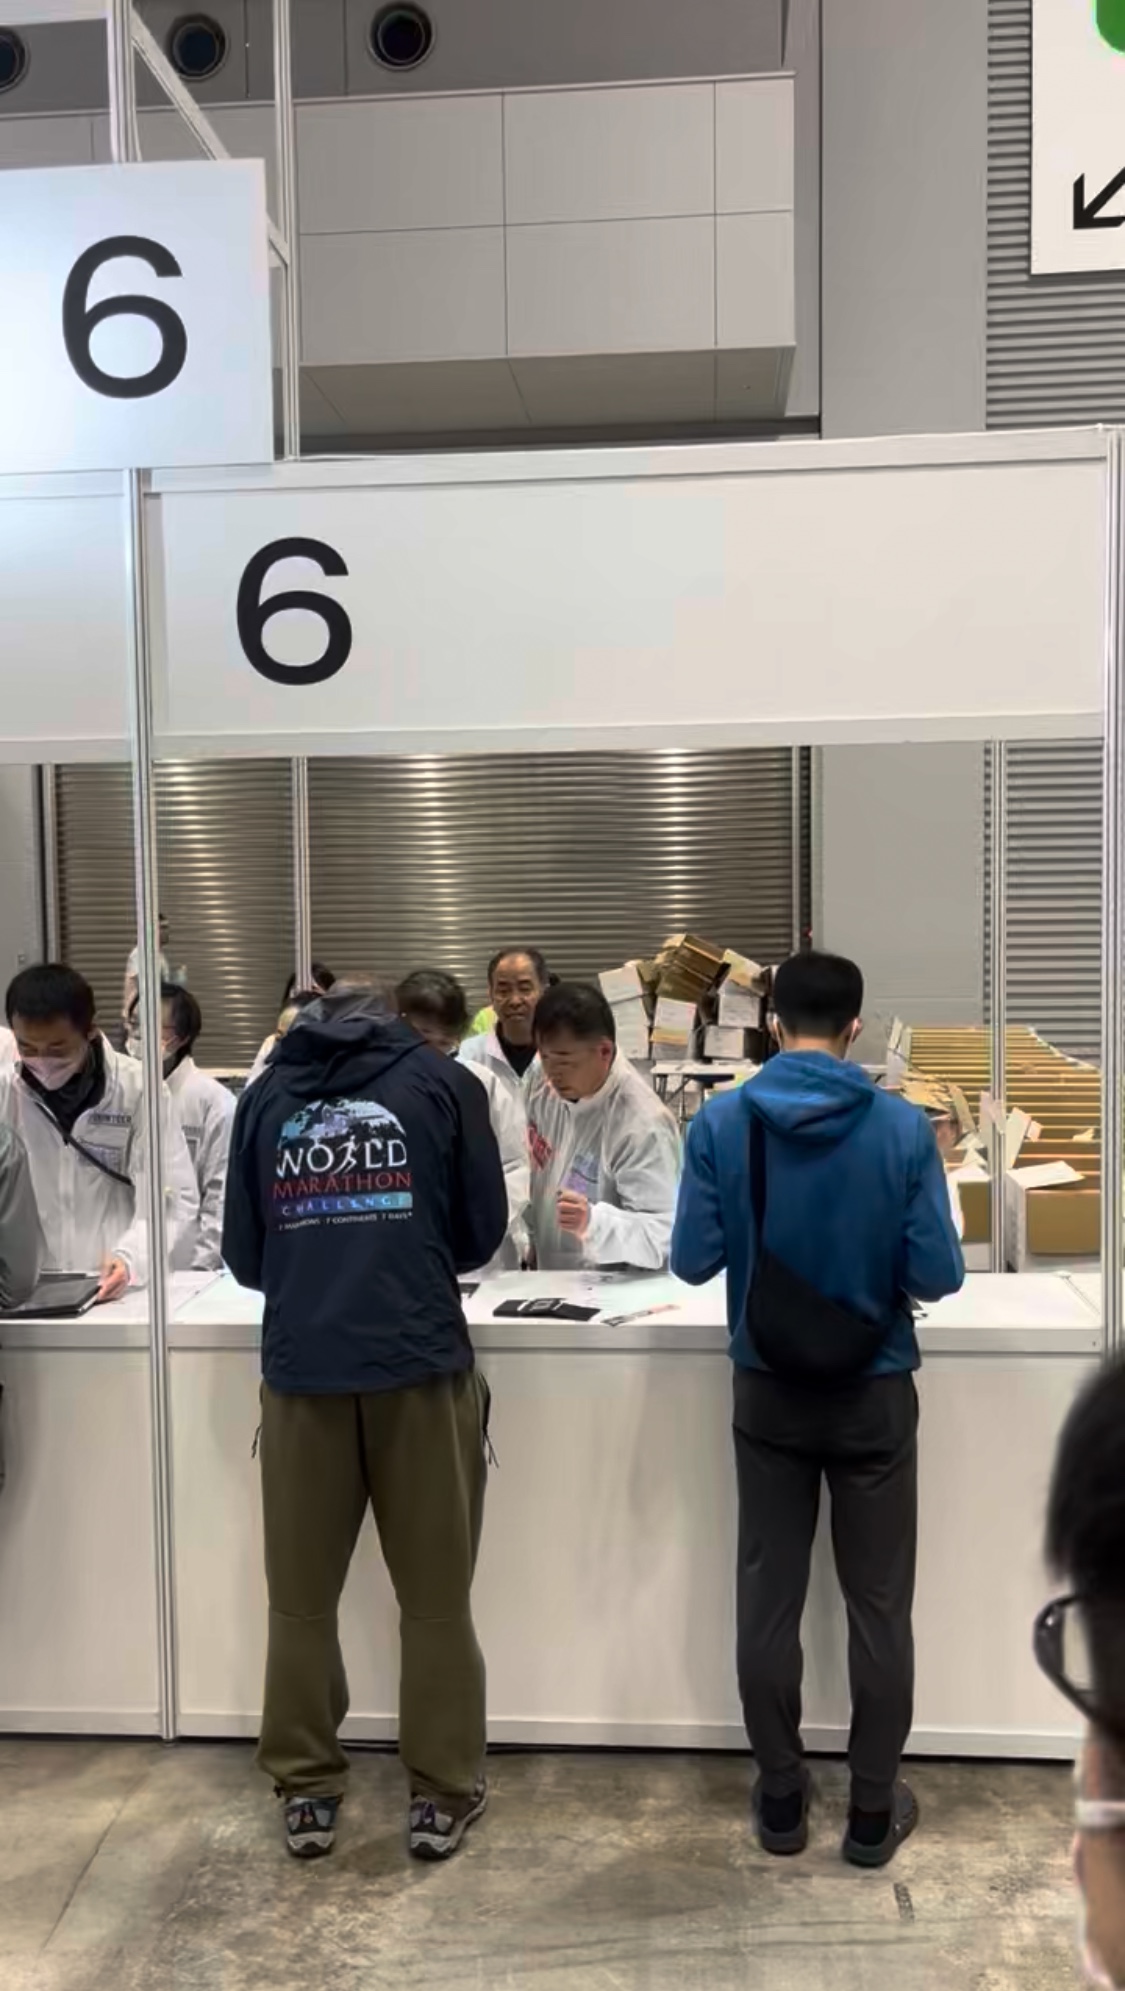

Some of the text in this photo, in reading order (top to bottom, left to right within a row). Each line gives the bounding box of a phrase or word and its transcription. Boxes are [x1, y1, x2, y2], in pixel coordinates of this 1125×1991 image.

[63, 235, 188, 399] 6
[236, 536, 353, 686] 6
[273, 1172, 411, 1199] MARATHON
